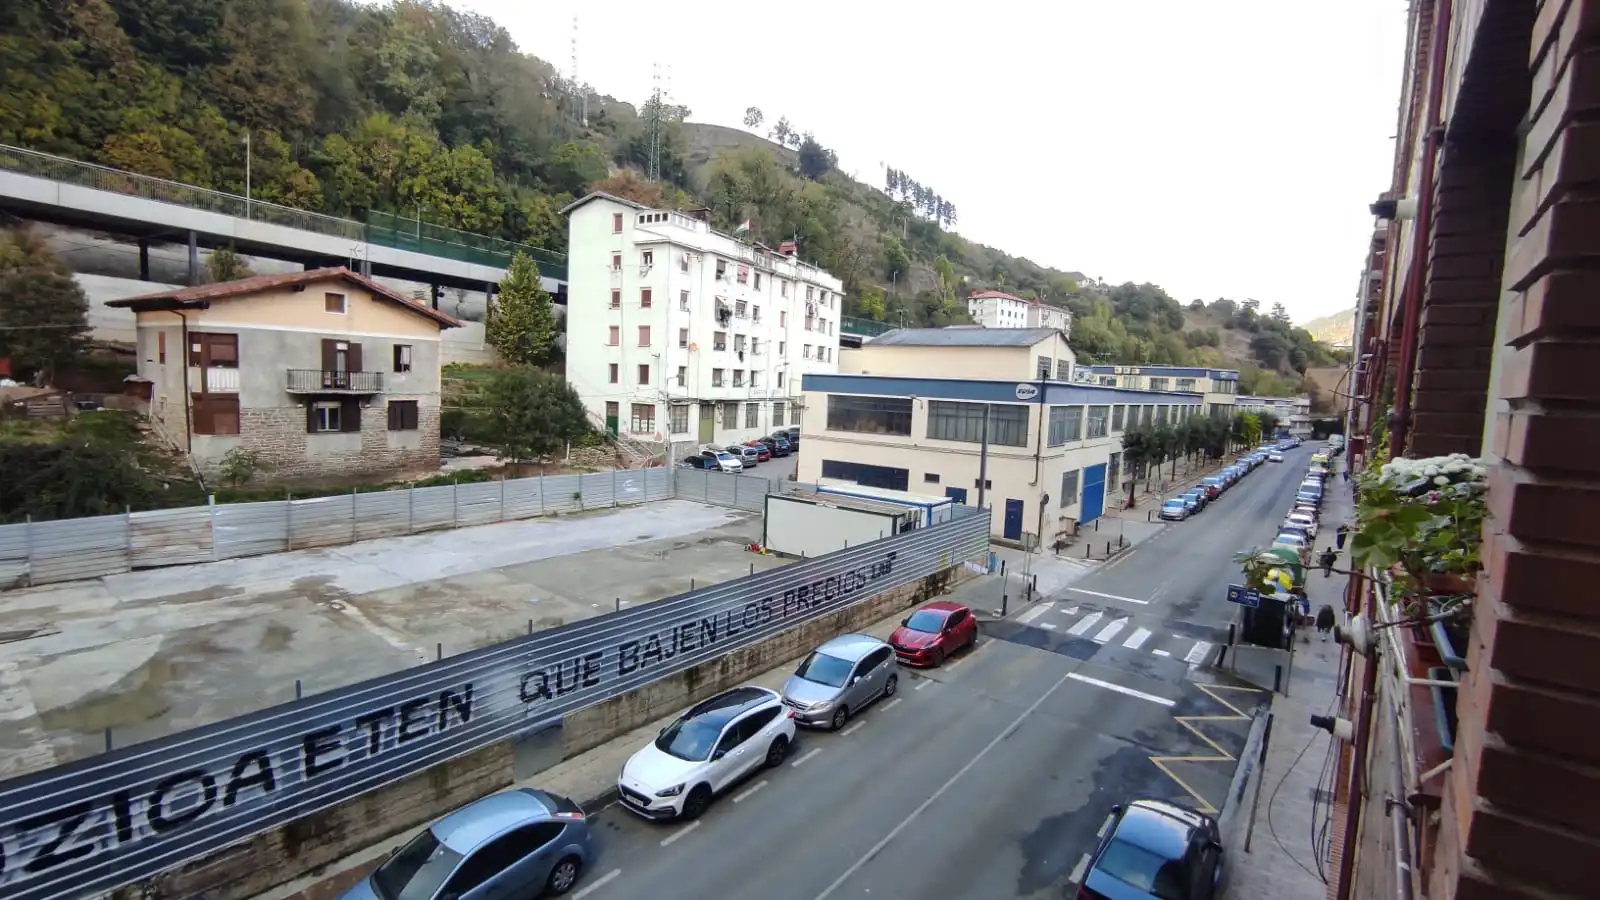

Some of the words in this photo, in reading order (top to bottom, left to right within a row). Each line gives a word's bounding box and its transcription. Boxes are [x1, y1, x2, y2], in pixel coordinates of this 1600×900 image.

[519, 651, 603, 702] QUE
[617, 614, 718, 677] BAJEN
[724, 597, 773, 638] LOS
[783, 566, 866, 617] PRECIOS
[0, 749, 276, 874] ZIOA
[303, 683, 474, 778] ETEN
